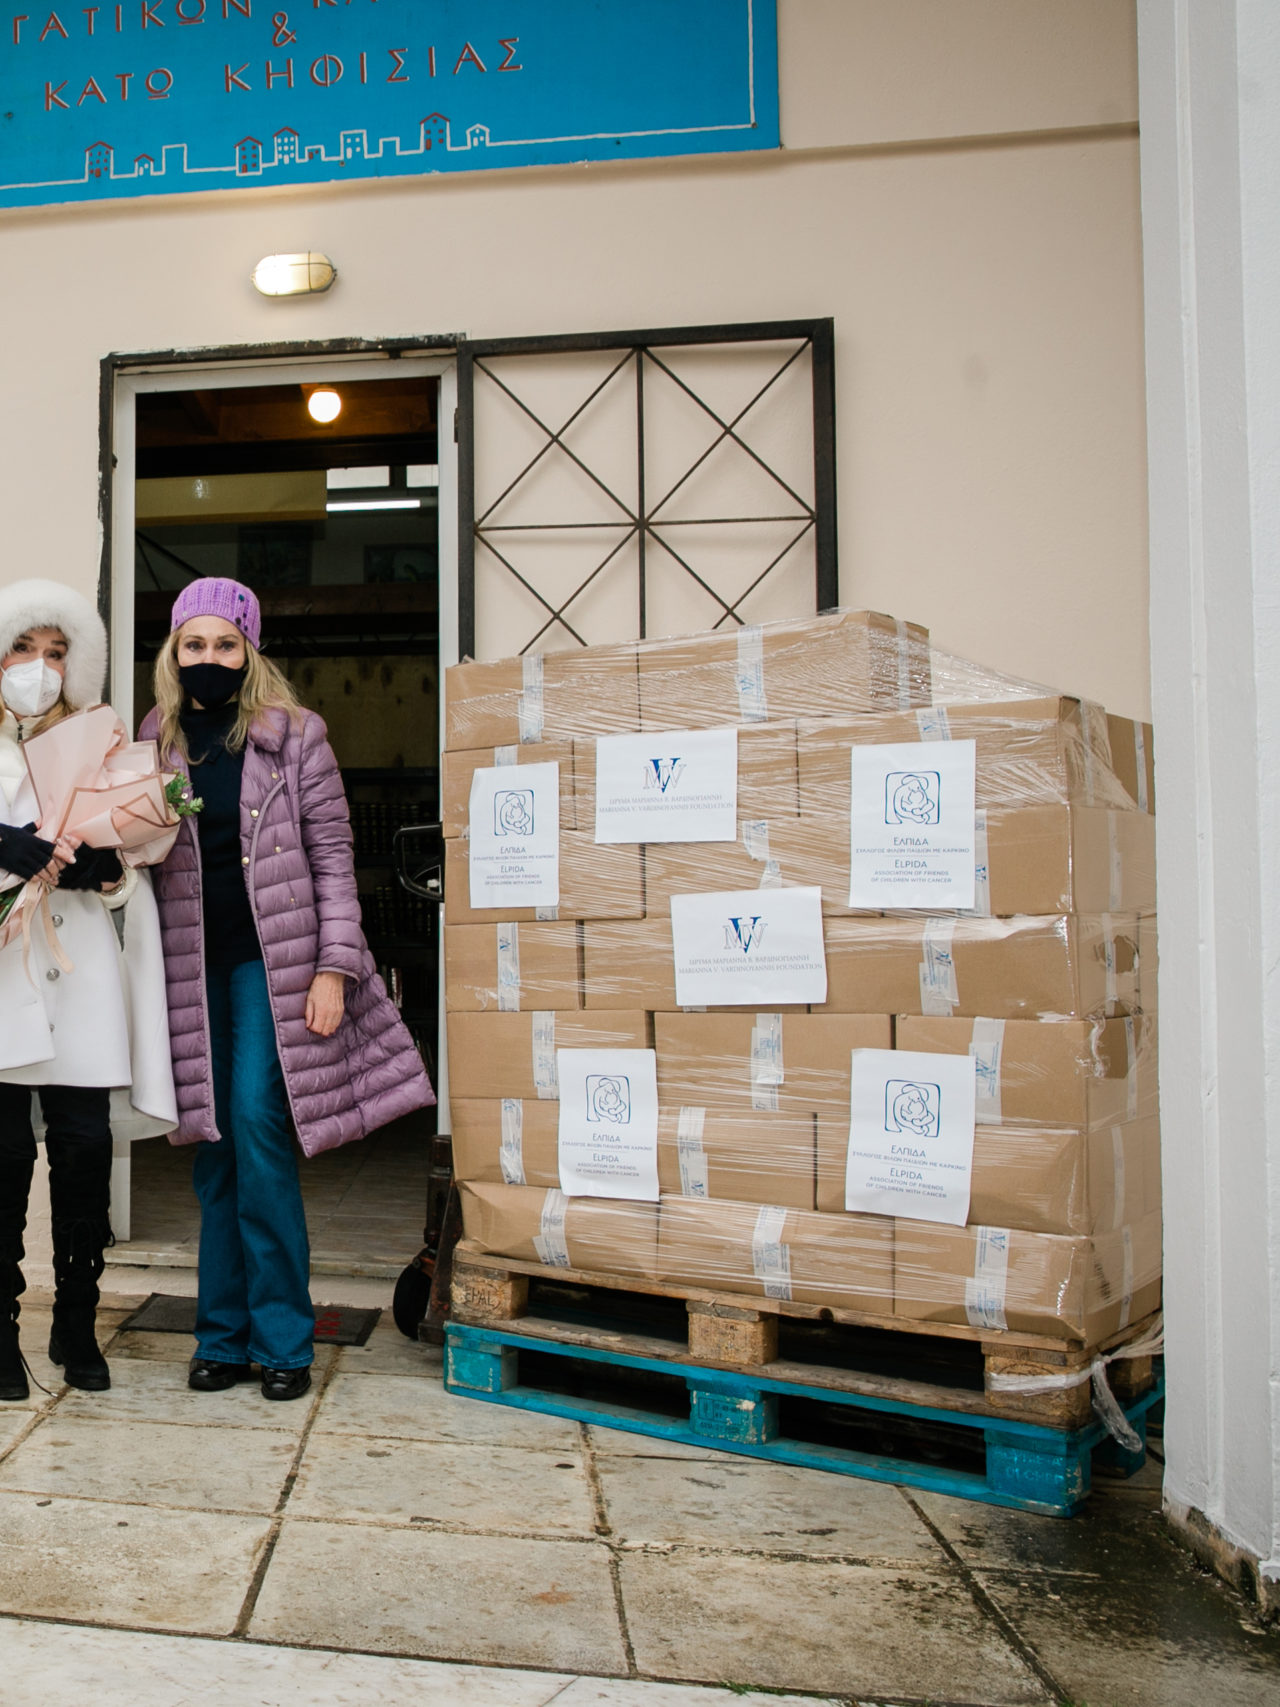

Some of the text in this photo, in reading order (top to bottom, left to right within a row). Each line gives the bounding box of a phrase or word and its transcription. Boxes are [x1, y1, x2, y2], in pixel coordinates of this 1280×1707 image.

[272, 11, 297, 48] &
[45, 37, 523, 111] ΚΑΤΩ ΚΗΦΙΣΙΑΣ
[895, 859, 927, 868] ELPIDA
[890, 1168, 923, 1180] ELPIDA
